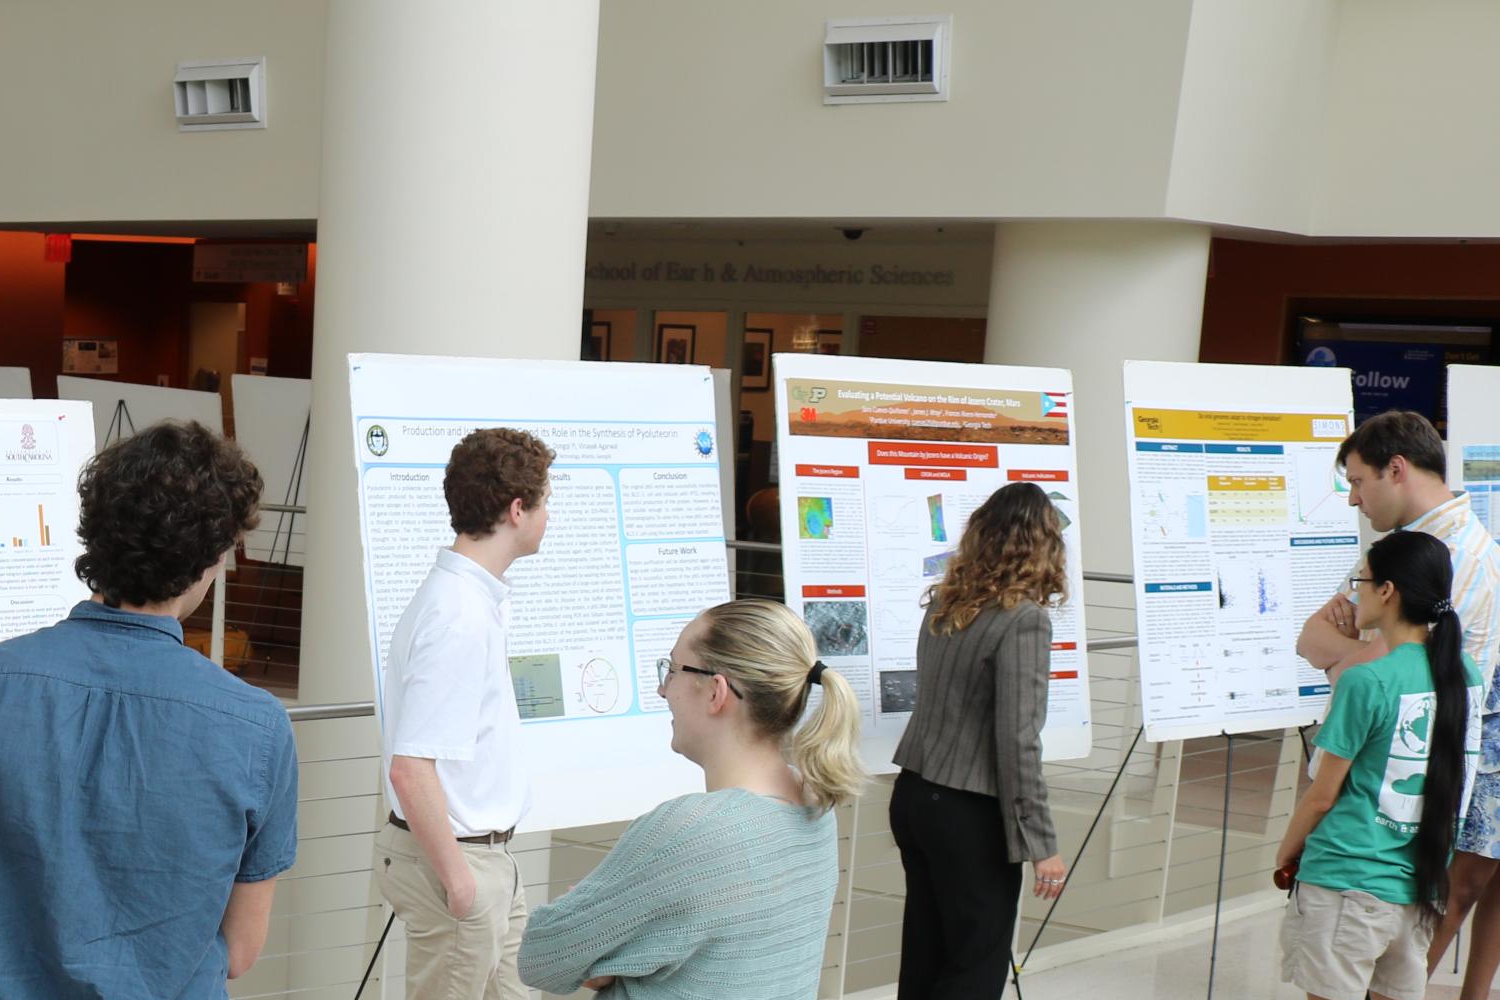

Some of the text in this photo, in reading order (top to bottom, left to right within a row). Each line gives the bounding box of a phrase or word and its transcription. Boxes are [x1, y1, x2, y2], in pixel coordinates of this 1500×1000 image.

[586, 262, 637, 280] chool
[643, 262, 662, 280] of
[721, 262, 738, 282] &
[742, 263, 863, 288] Atmospheric
[870, 264, 955, 287] Sciences
[800, 407, 817, 422] 3M
[402, 425, 446, 437] Production
[448, 426, 462, 436] and
[1314, 421, 1345, 430] SIMONS
[552, 428, 568, 438] Role
[570, 428, 577, 438] in
[578, 428, 591, 438] the
[592, 428, 626, 440] Synthesis
[627, 428, 636, 438] of
[636, 429, 678, 440] Pyoluteorin
[390, 472, 430, 482] Introduction
[652, 472, 688, 481] Conclusion
[658, 547, 697, 556] Future Work
[1374, 815, 1398, 831] earth
[1400, 824, 1408, 833] &
